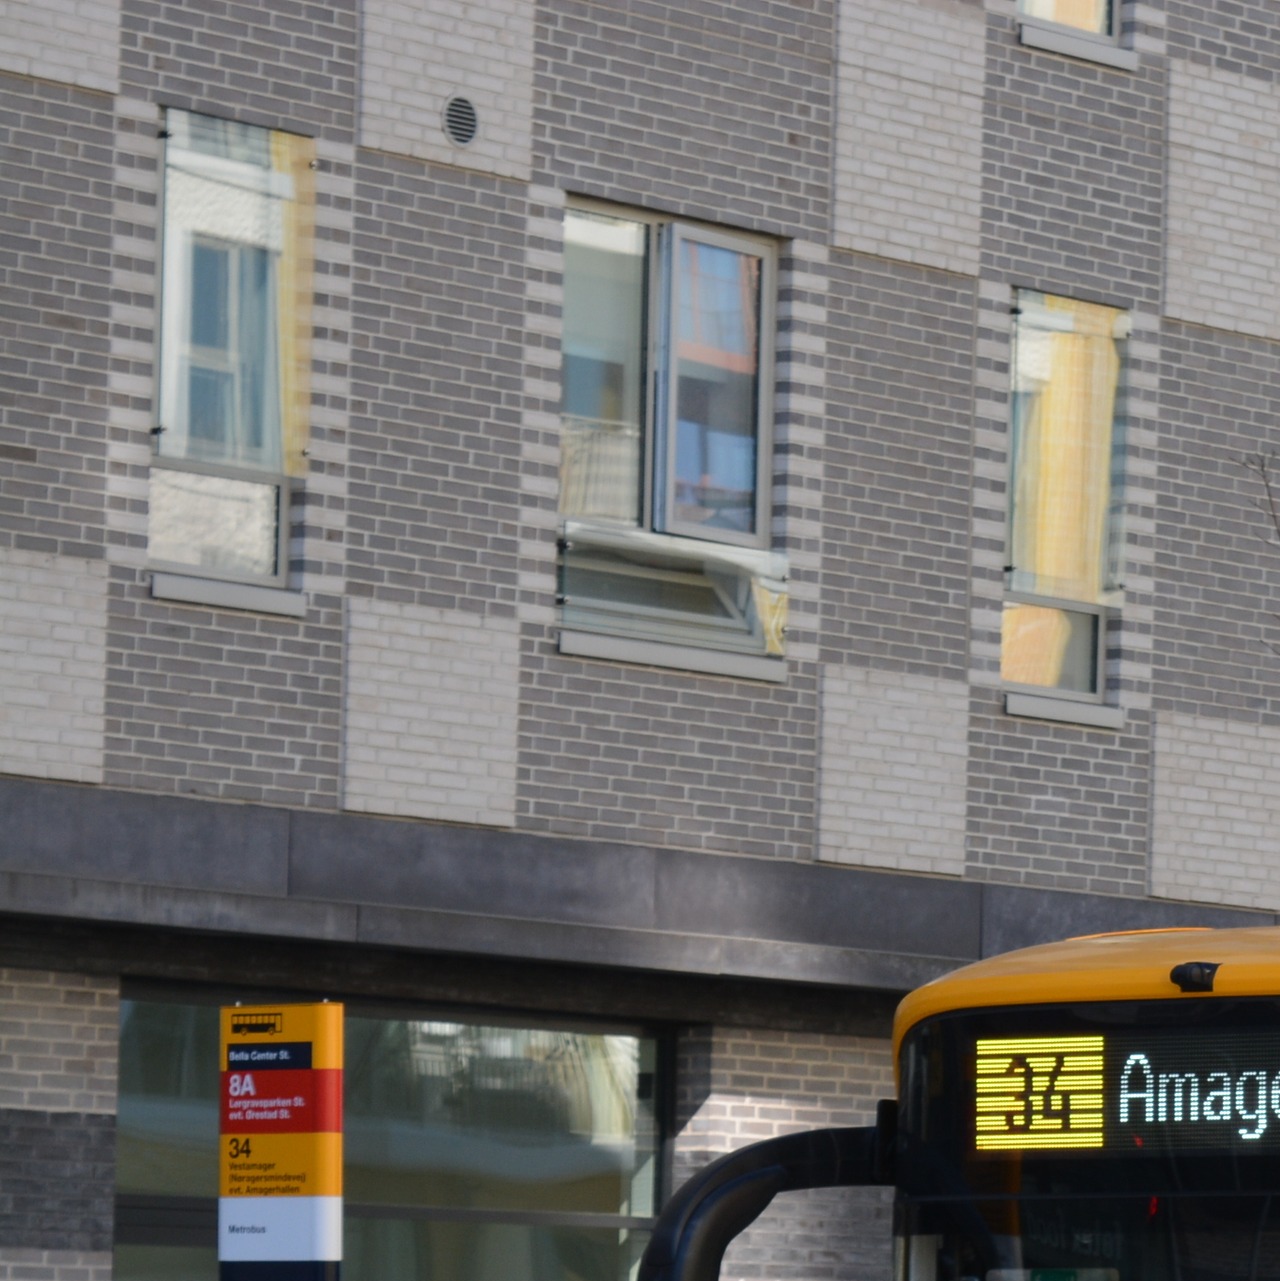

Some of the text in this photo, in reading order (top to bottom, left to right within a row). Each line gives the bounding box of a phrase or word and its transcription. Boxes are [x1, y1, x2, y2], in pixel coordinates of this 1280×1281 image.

[229, 1049, 291, 1061] Bella Center St.
[229, 1073, 256, 1097] 8A
[1000, 1055, 1071, 1131] 34
[293, 1096, 306, 1107] St.
[229, 1111, 244, 1120] evt.
[279, 1108, 291, 1119] St.
[228, 1138, 251, 1159] 34
[229, 1162, 276, 1172] Vestamager
[245, 1185, 300, 1196] Amagerhallen
[228, 1225, 266, 1235] Metrobus
